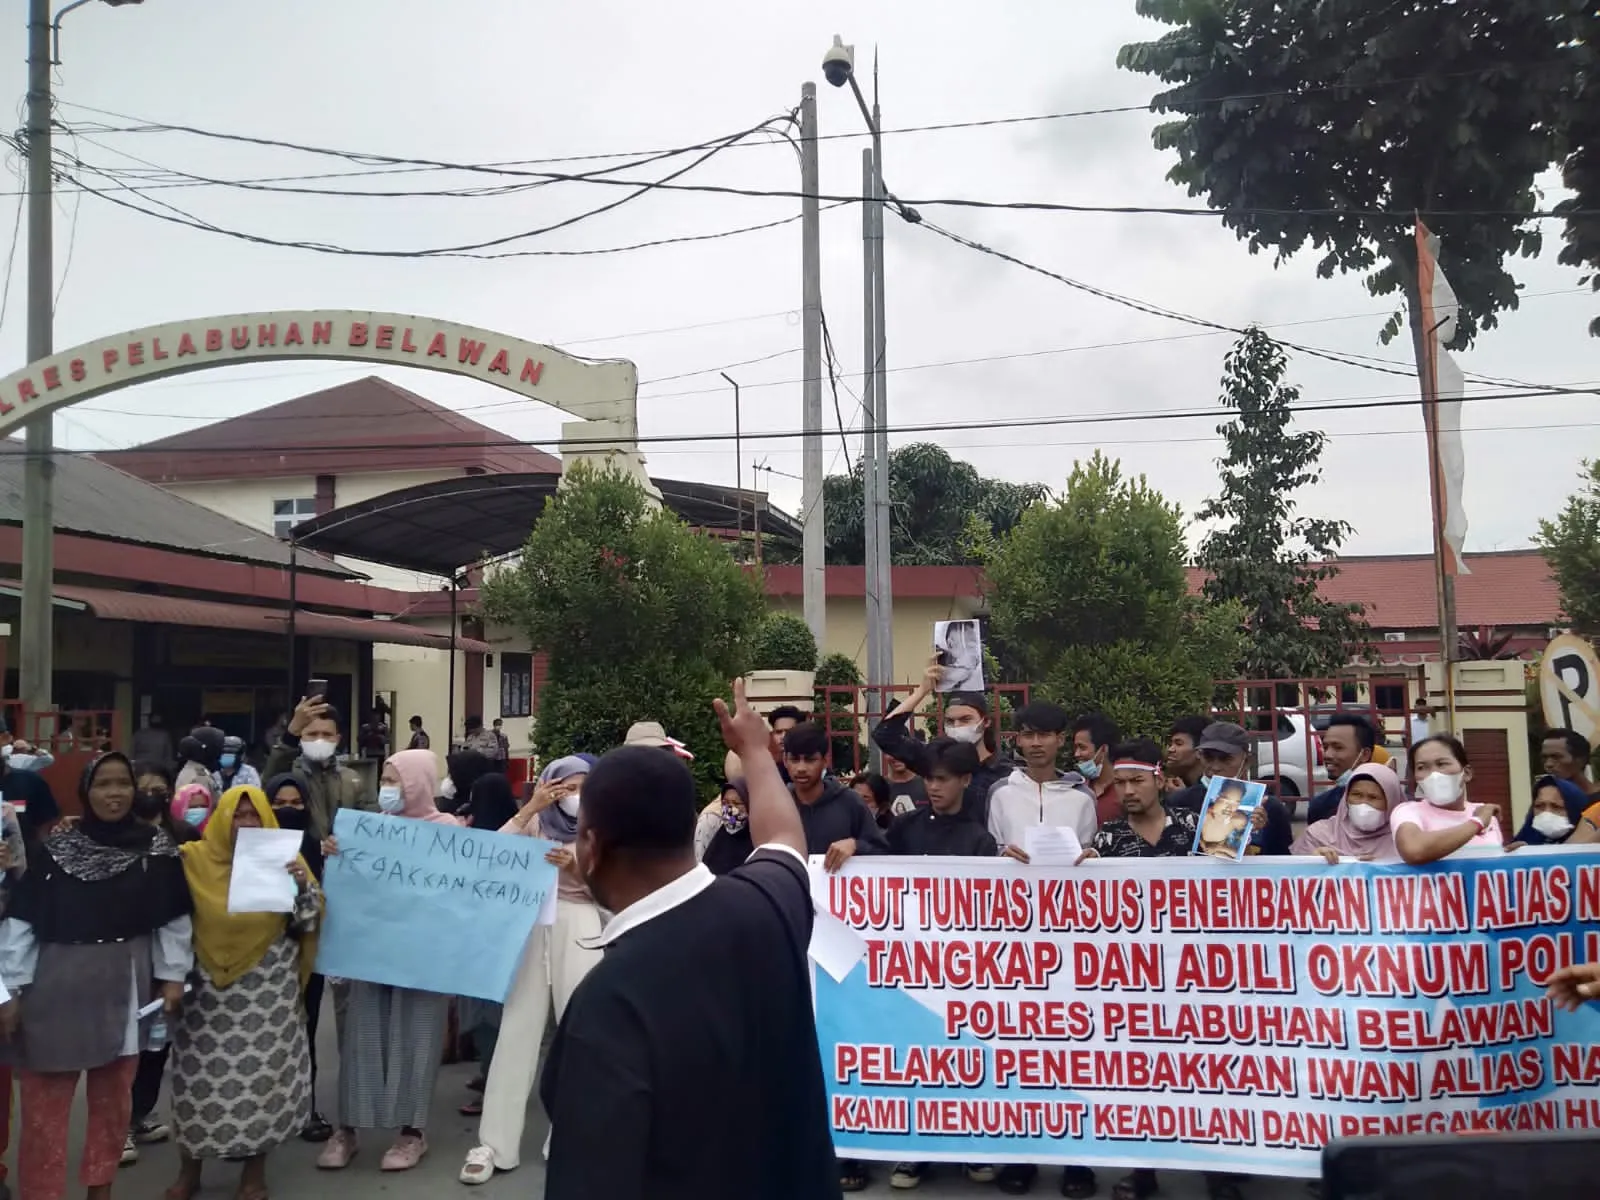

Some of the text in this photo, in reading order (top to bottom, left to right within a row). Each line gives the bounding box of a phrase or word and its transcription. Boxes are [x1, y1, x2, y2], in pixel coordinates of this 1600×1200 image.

[102, 320, 333, 373] PELABUHAN
[348, 321, 546, 386] BELAWAN
[354, 814, 530, 871] KAMI MOHON
[827, 875, 906, 927] USUT
[912, 876, 1029, 928] TUNTAS
[1037, 877, 1140, 930] KASUS
[1148, 877, 1367, 931] PENEMBAKAN
[1375, 873, 1466, 930] IWAN
[1475, 866, 1569, 929] ALIAS
[863, 938, 1059, 987] TANGKAP
[1072, 941, 1161, 988] DAN
[1175, 942, 1293, 990] ADILI
[1307, 942, 1488, 994] OKNUM
[944, 999, 1551, 1048] POLRES PELABUHAN BELAWAN
[835, 1045, 983, 1085] PELAKU
[994, 1048, 1292, 1094] PENEMBAKKAN
[1306, 1057, 1417, 1098] IWAN
[1429, 1048, 1542, 1094] ALIAS
[832, 1096, 907, 1131] KAMI
[915, 1100, 1085, 1135] MENUNTUT
[1093, 1103, 1252, 1141] KEADILAN
[1261, 1109, 1330, 1147] DAN
[1339, 1099, 1556, 1136] PENEGAKKAN
